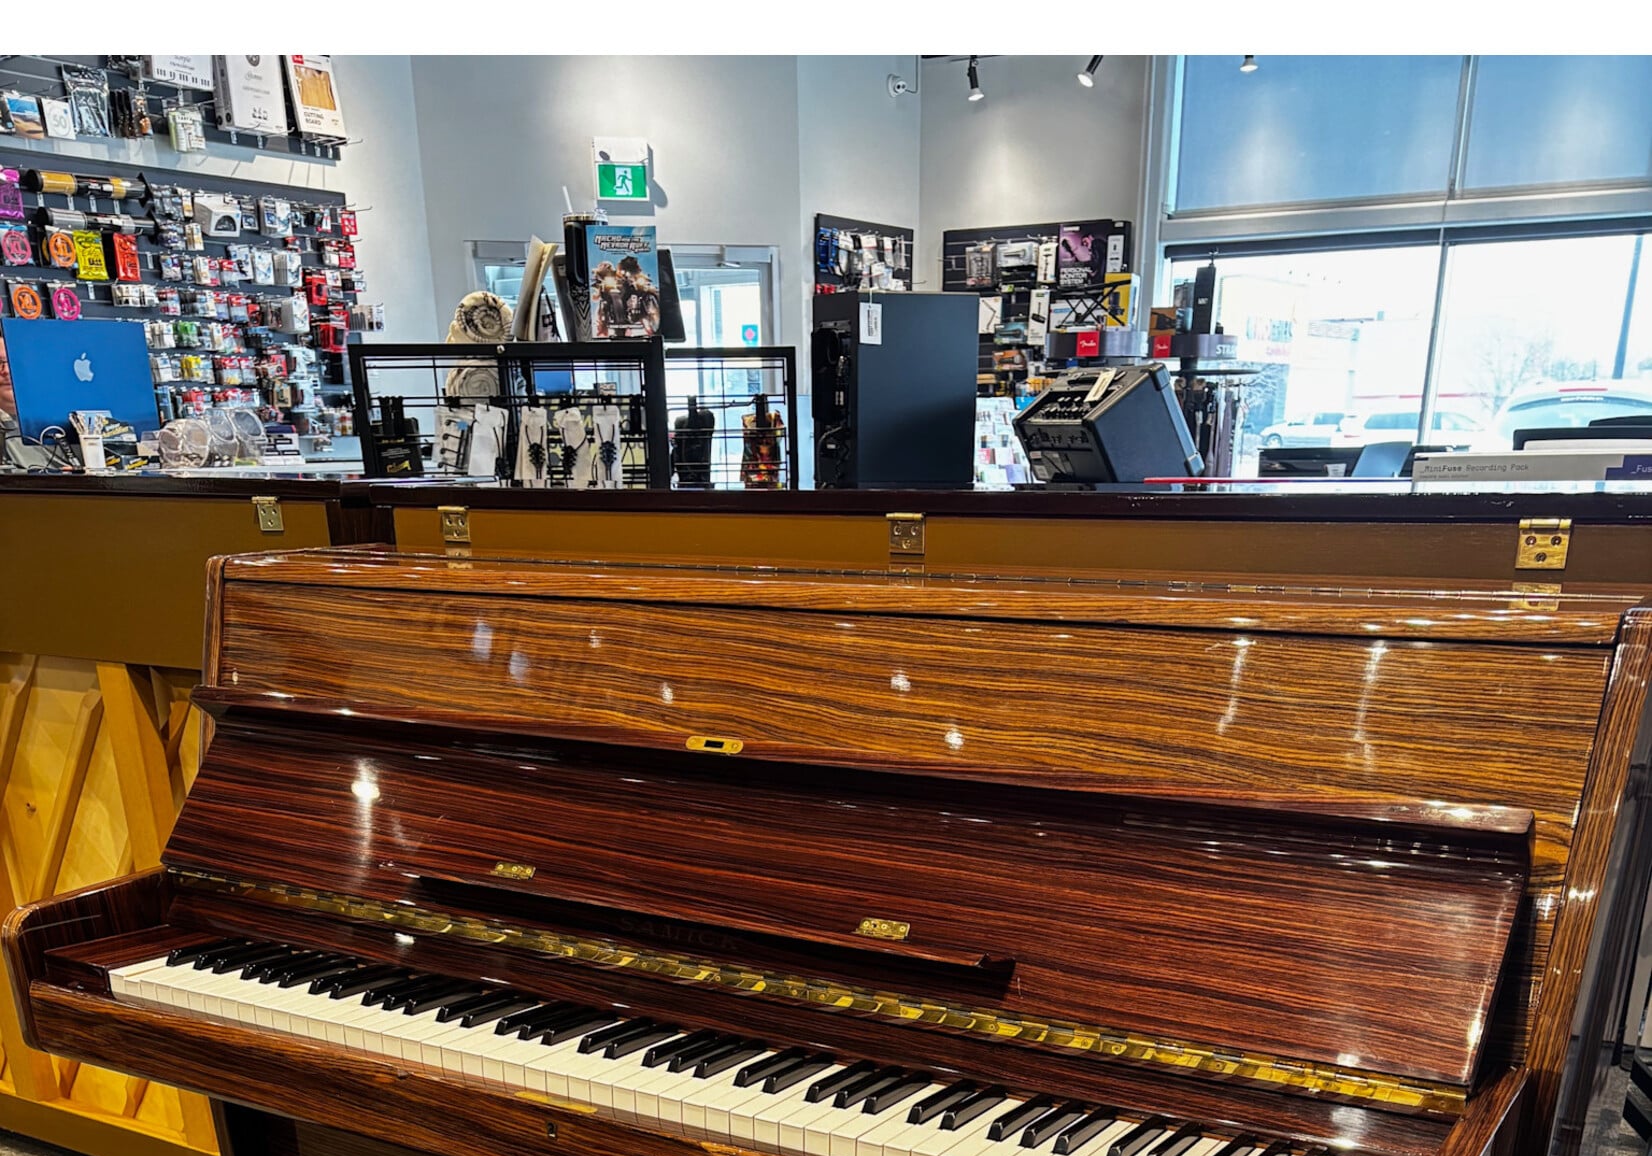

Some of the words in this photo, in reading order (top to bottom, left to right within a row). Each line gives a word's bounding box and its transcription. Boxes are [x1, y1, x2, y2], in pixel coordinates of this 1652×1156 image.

[1465, 464, 1507, 473] Recording
[1510, 463, 1529, 471] Pack
[619, 916, 738, 950] SAMICK
